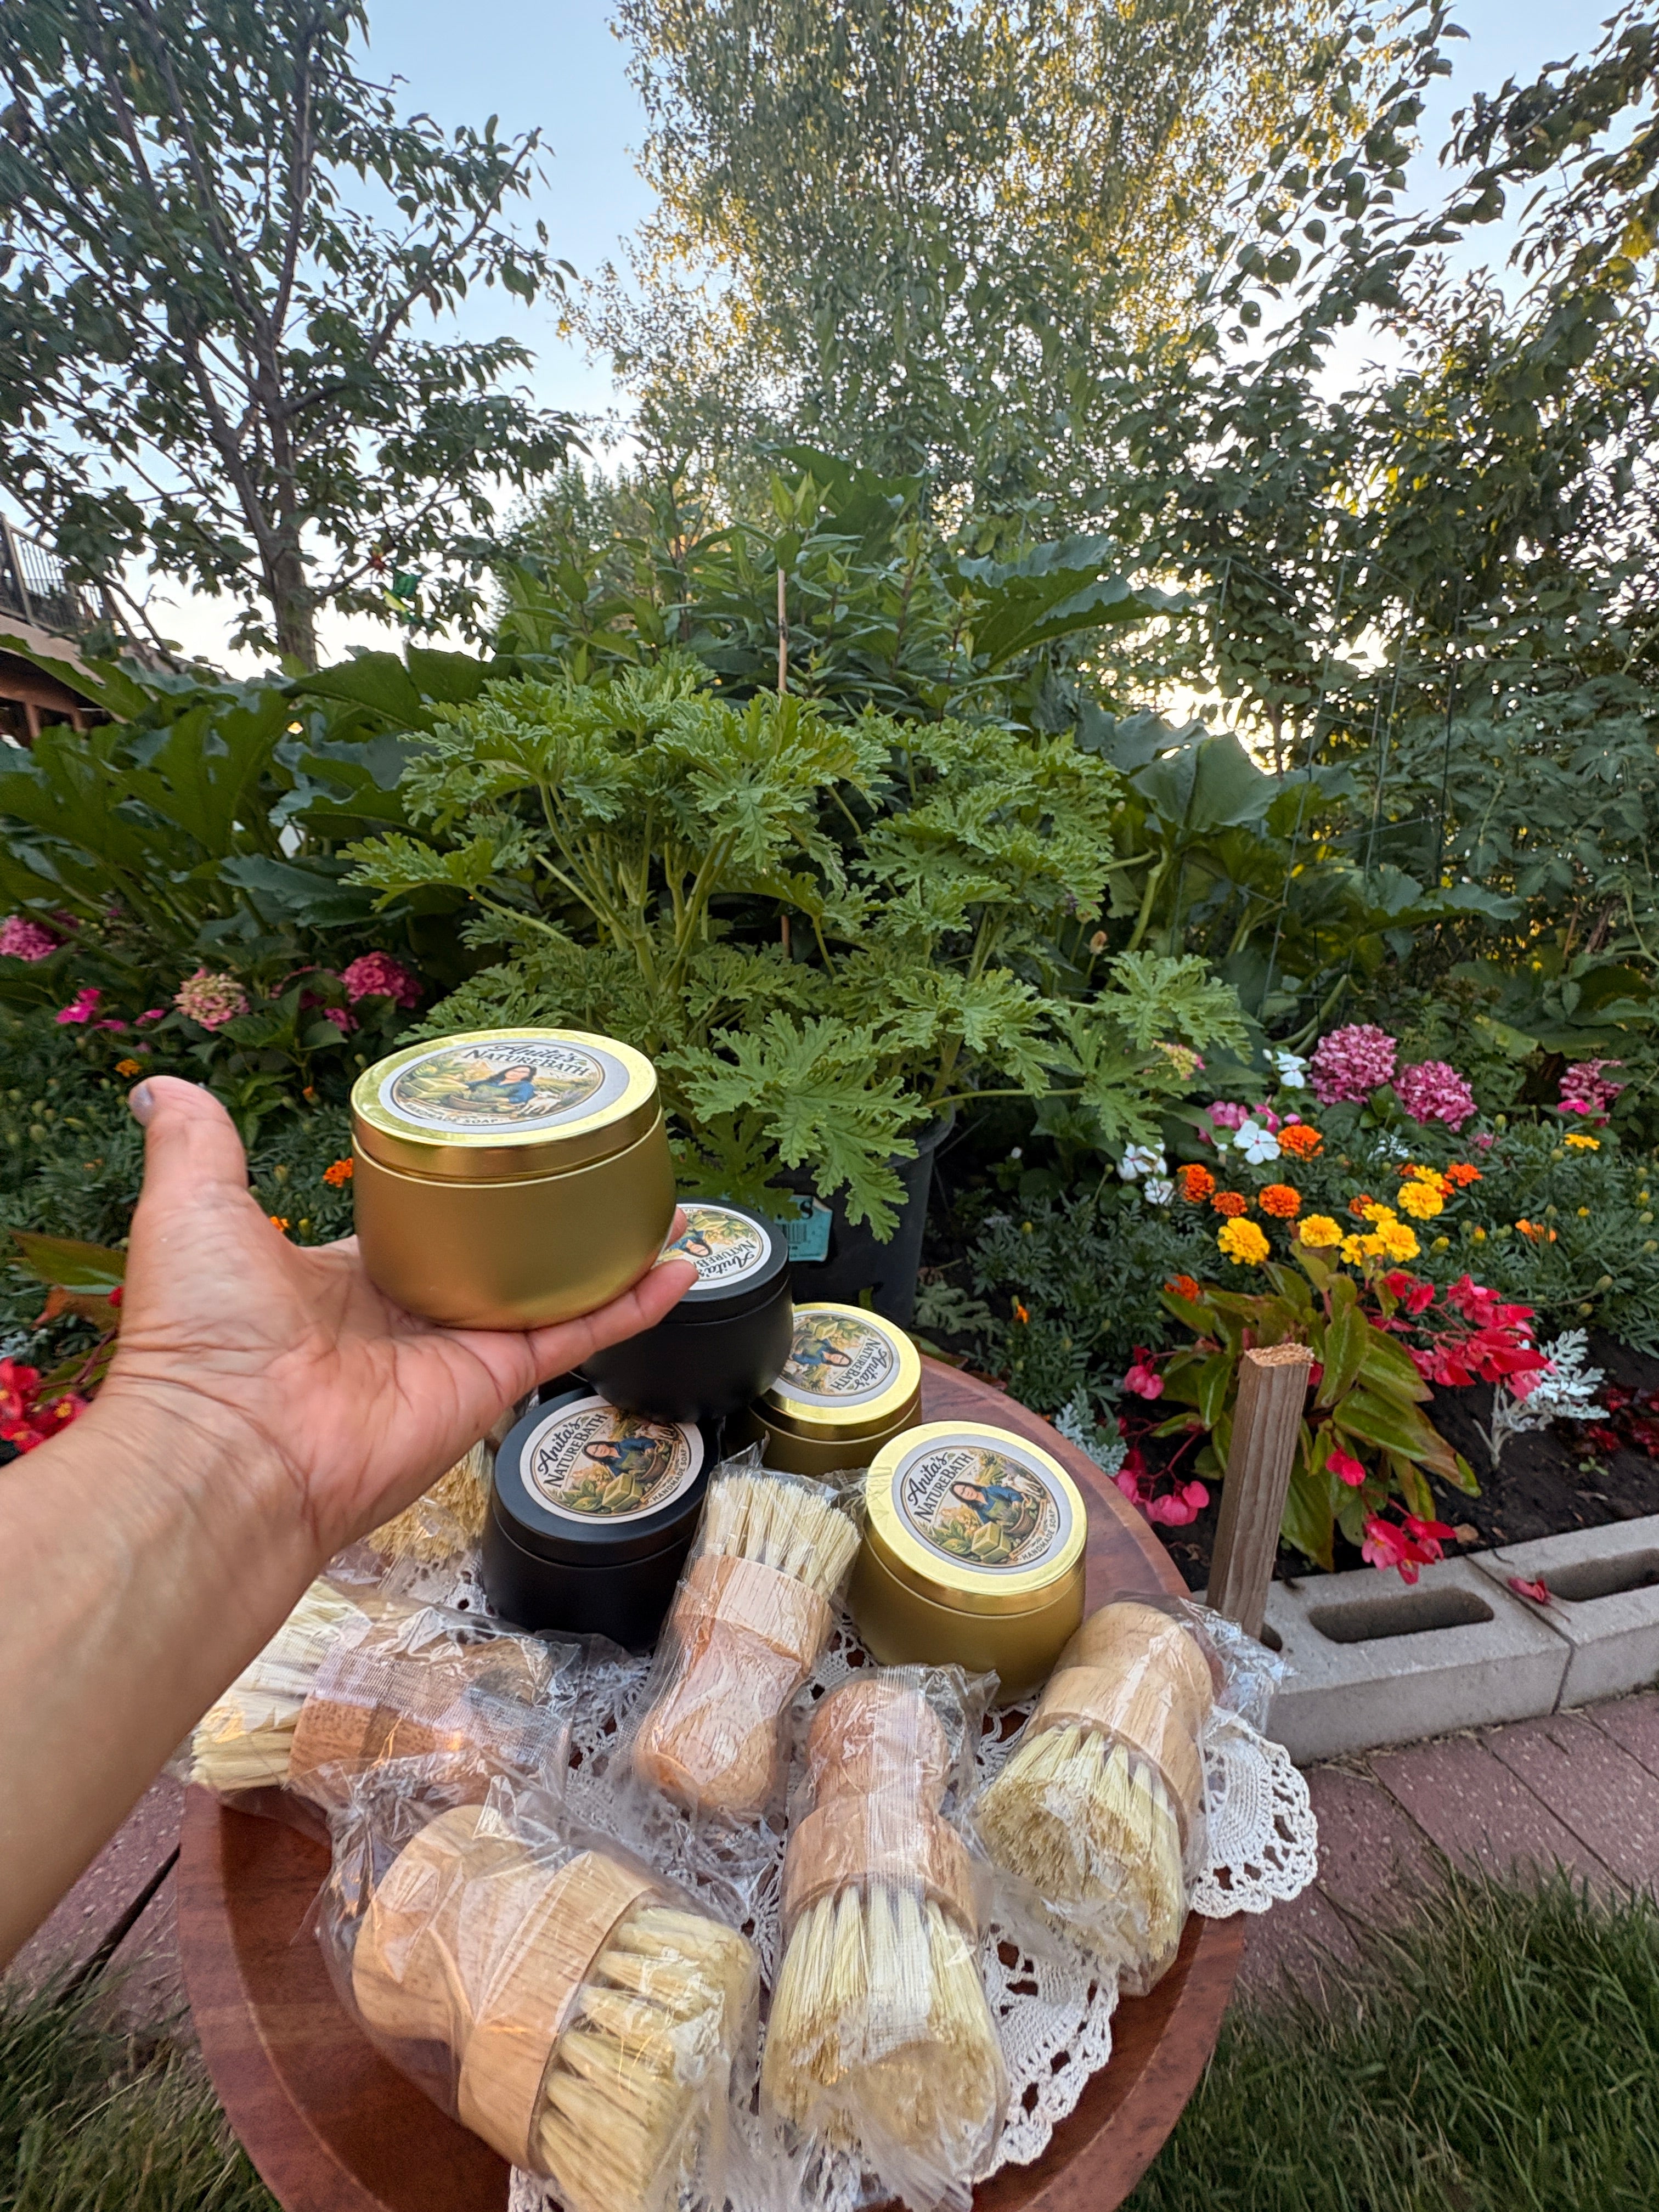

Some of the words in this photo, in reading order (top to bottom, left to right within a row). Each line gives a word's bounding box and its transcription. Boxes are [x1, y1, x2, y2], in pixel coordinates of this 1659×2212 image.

[488, 1045, 587, 1063] Anita's
[853, 1348, 887, 1390] Anita's
[538, 1416, 582, 1475] Anita's
[652, 1466, 686, 1502] HANDMADE
[680, 1448, 690, 1467] SOAP
[907, 1452, 947, 1505] Anita's
[1021, 1528, 1056, 1561] HANDMADE
